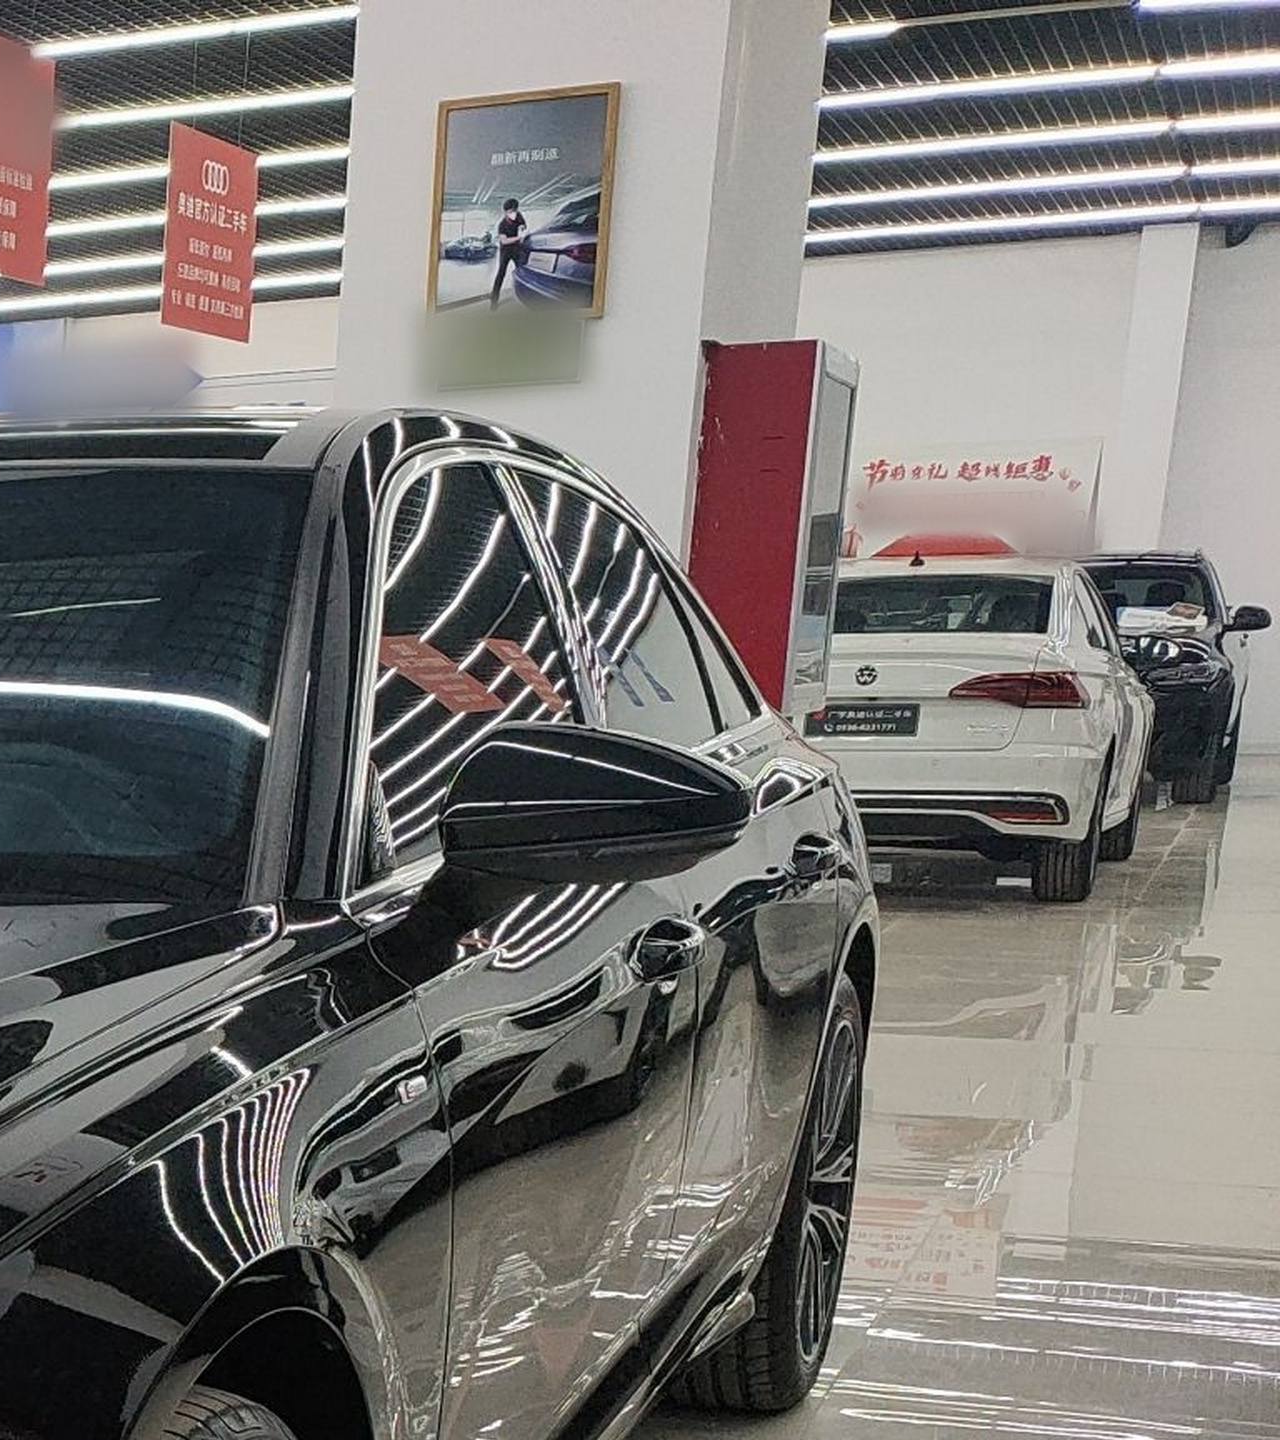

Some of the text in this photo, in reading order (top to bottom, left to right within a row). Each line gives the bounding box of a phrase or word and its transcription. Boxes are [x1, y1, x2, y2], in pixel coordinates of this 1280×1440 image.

[176, 191, 249, 236] 奥迪官方认证二手车
